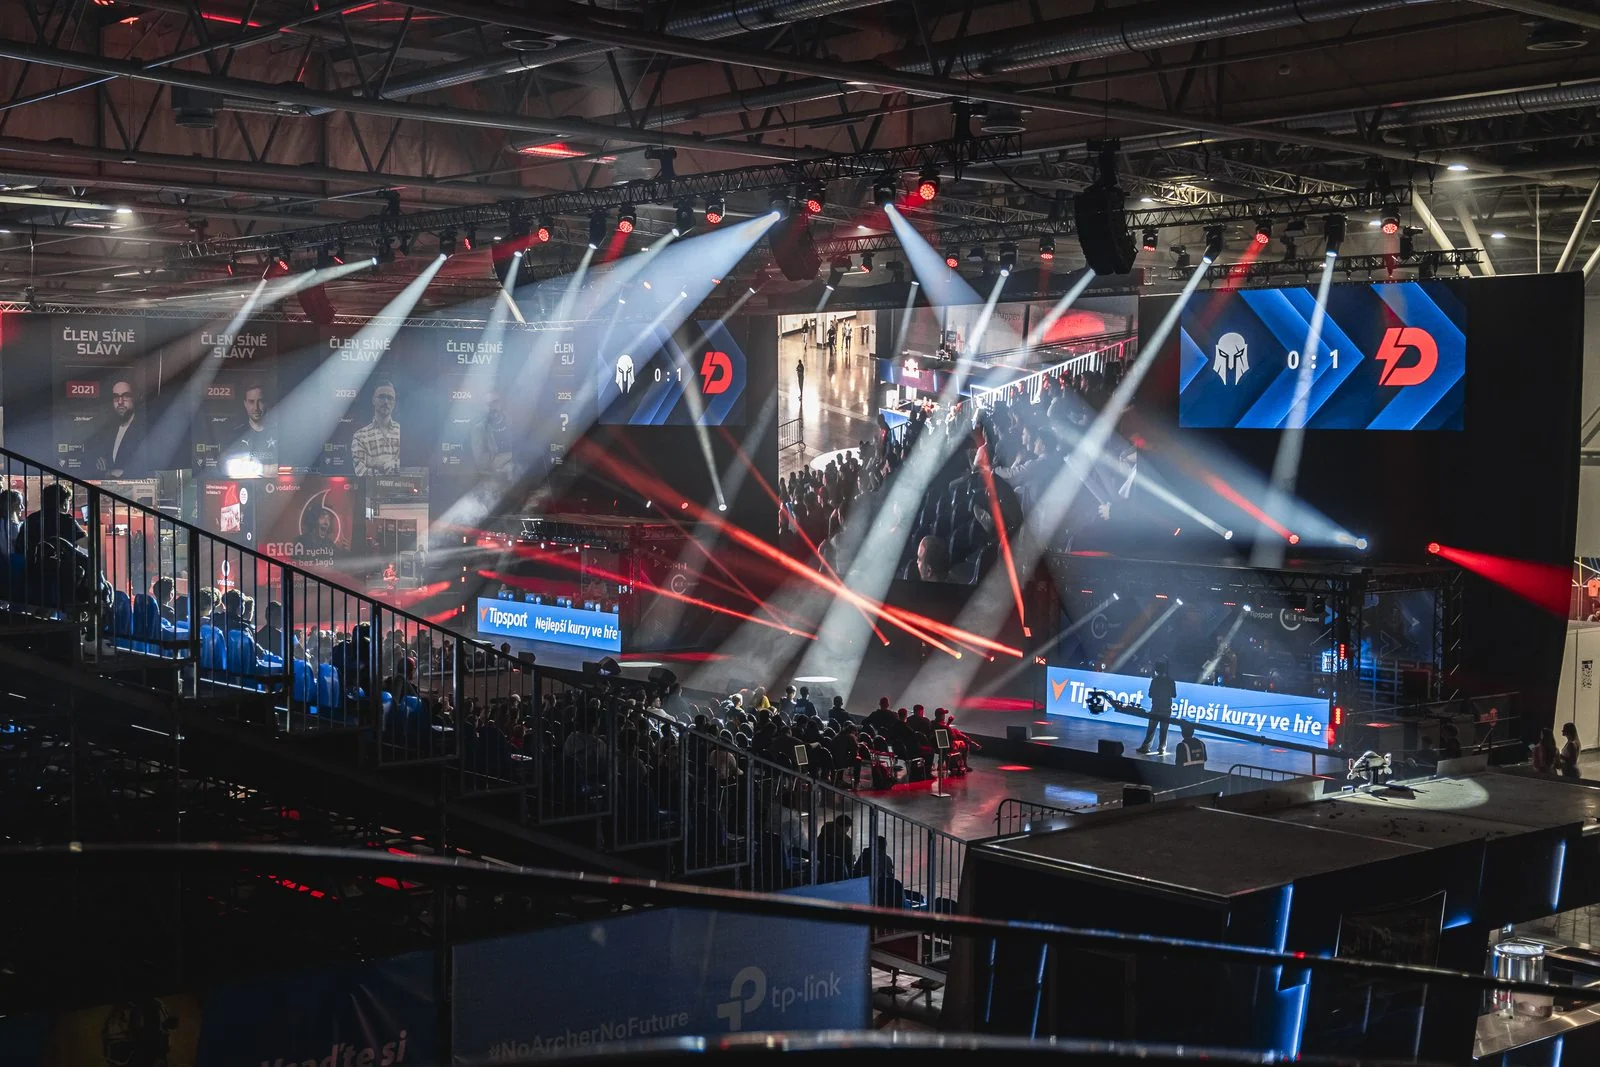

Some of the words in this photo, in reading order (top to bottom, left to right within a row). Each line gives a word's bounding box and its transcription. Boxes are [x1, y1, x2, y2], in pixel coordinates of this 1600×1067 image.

[63, 327, 98, 342] ČLEN
[102, 328, 136, 343] SÍNĚ
[201, 332, 233, 346] ČLEN
[237, 333, 268, 347] SÍNĚ
[77, 341, 122, 356] SLÁVY
[329, 336, 359, 349] ČLEN
[362, 336, 391, 351] SÍNĚ
[446, 340, 475, 353] ČLEN
[477, 340, 503, 353] SÍNĚ
[554, 341, 574, 354] ČLEN
[213, 345, 255, 359] SLÁVY
[341, 348, 379, 362] SLÁVY
[457, 351, 493, 364] SLÁVY
[71, 385, 95, 395] 2021
[208, 387, 231, 396] 2022
[335, 389, 356, 398] 2023
[452, 391, 472, 399] 2024
[558, 392, 572, 400] 2025
[266, 542, 304, 556] GIGA
[306, 547, 334, 557] rychlý
[216, 578, 235, 587] vodfone
[489, 607, 528, 627] Tipsport
[535, 616, 566, 635] Nejlepší
[567, 620, 591, 639] kurzy
[592, 627, 602, 638] ve
[603, 626, 618, 640] hře
[1168, 698, 1220, 723] ejlepší
[1221, 704, 1267, 732] kurzy
[1269, 715, 1290, 731] ve
[1293, 713, 1322, 736] hře
[771, 971, 841, 1012] tp-link
[488, 1009, 689, 1062] #NoArcherNoFuture
